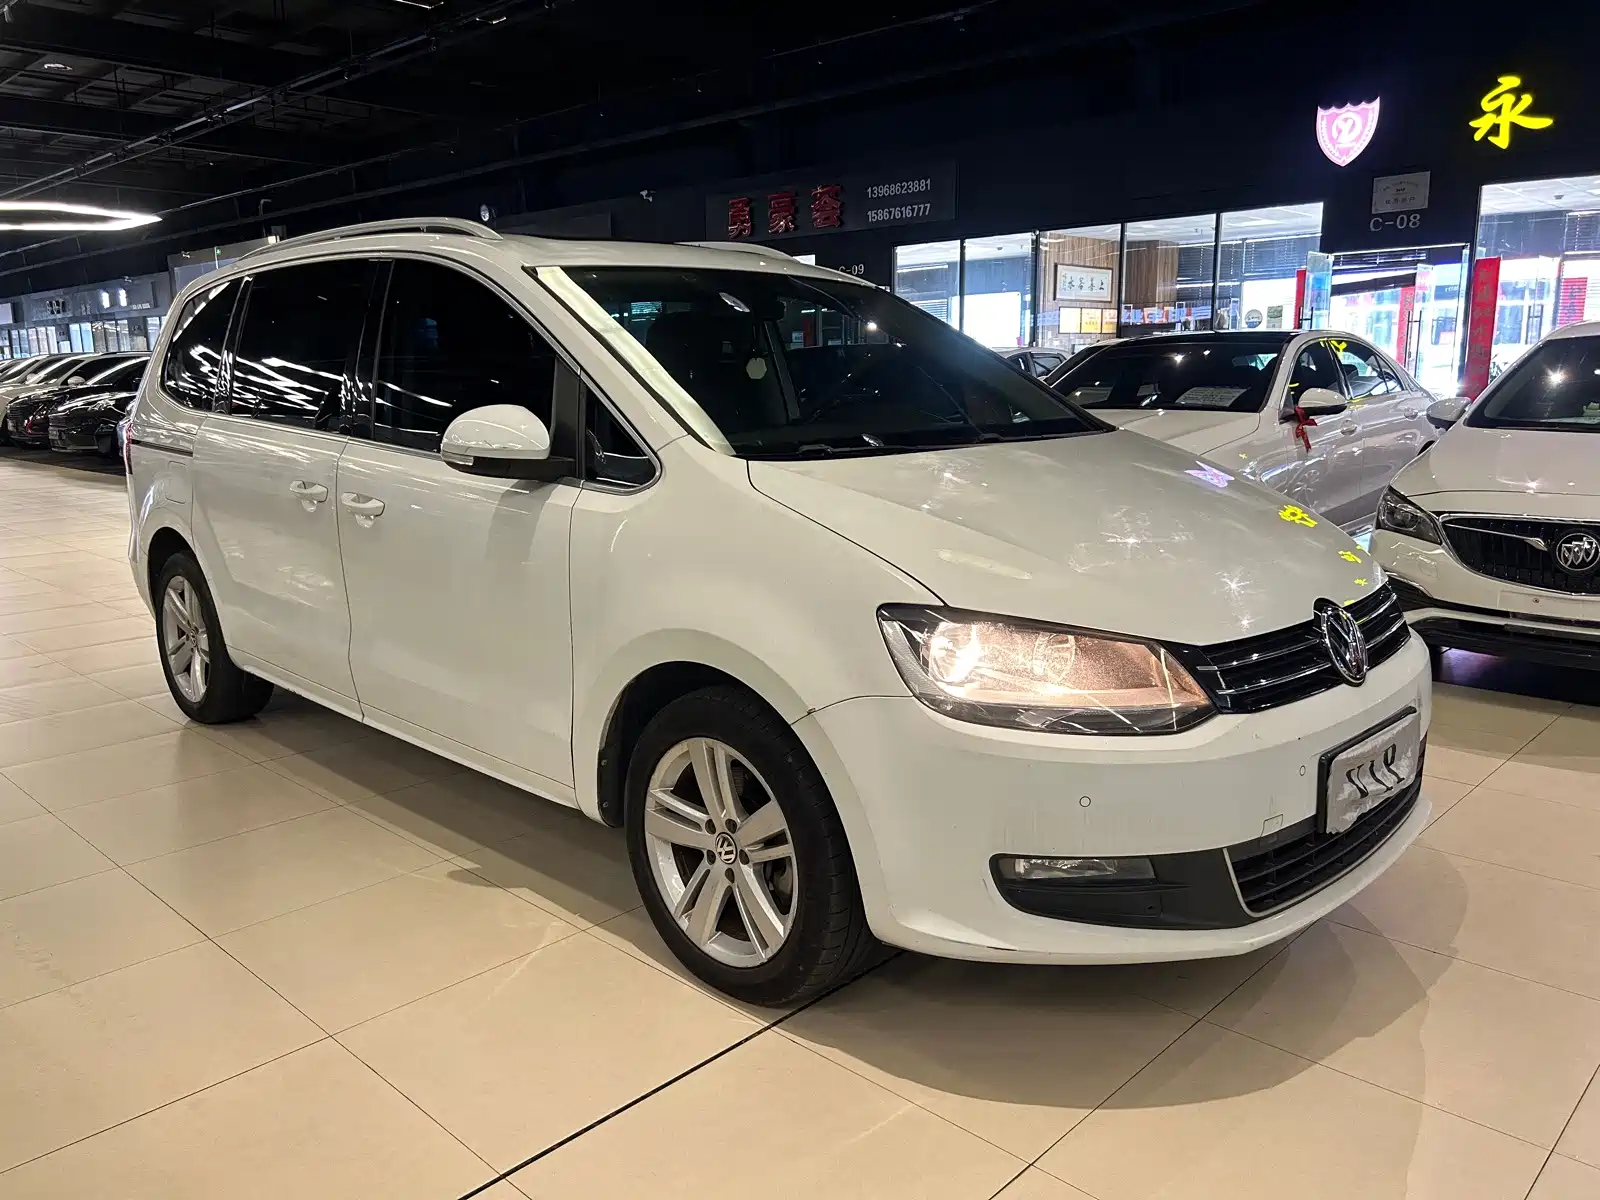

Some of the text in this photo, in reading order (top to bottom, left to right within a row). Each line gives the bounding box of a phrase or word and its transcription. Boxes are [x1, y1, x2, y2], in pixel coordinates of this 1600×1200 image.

[1469, 75, 1554, 149] 永
[866, 178, 931, 198] 13968623881
[866, 203, 931, 222] 15867616777
[1369, 213, 1421, 232] C-08
[1344, 742, 1406, 800] VIP
